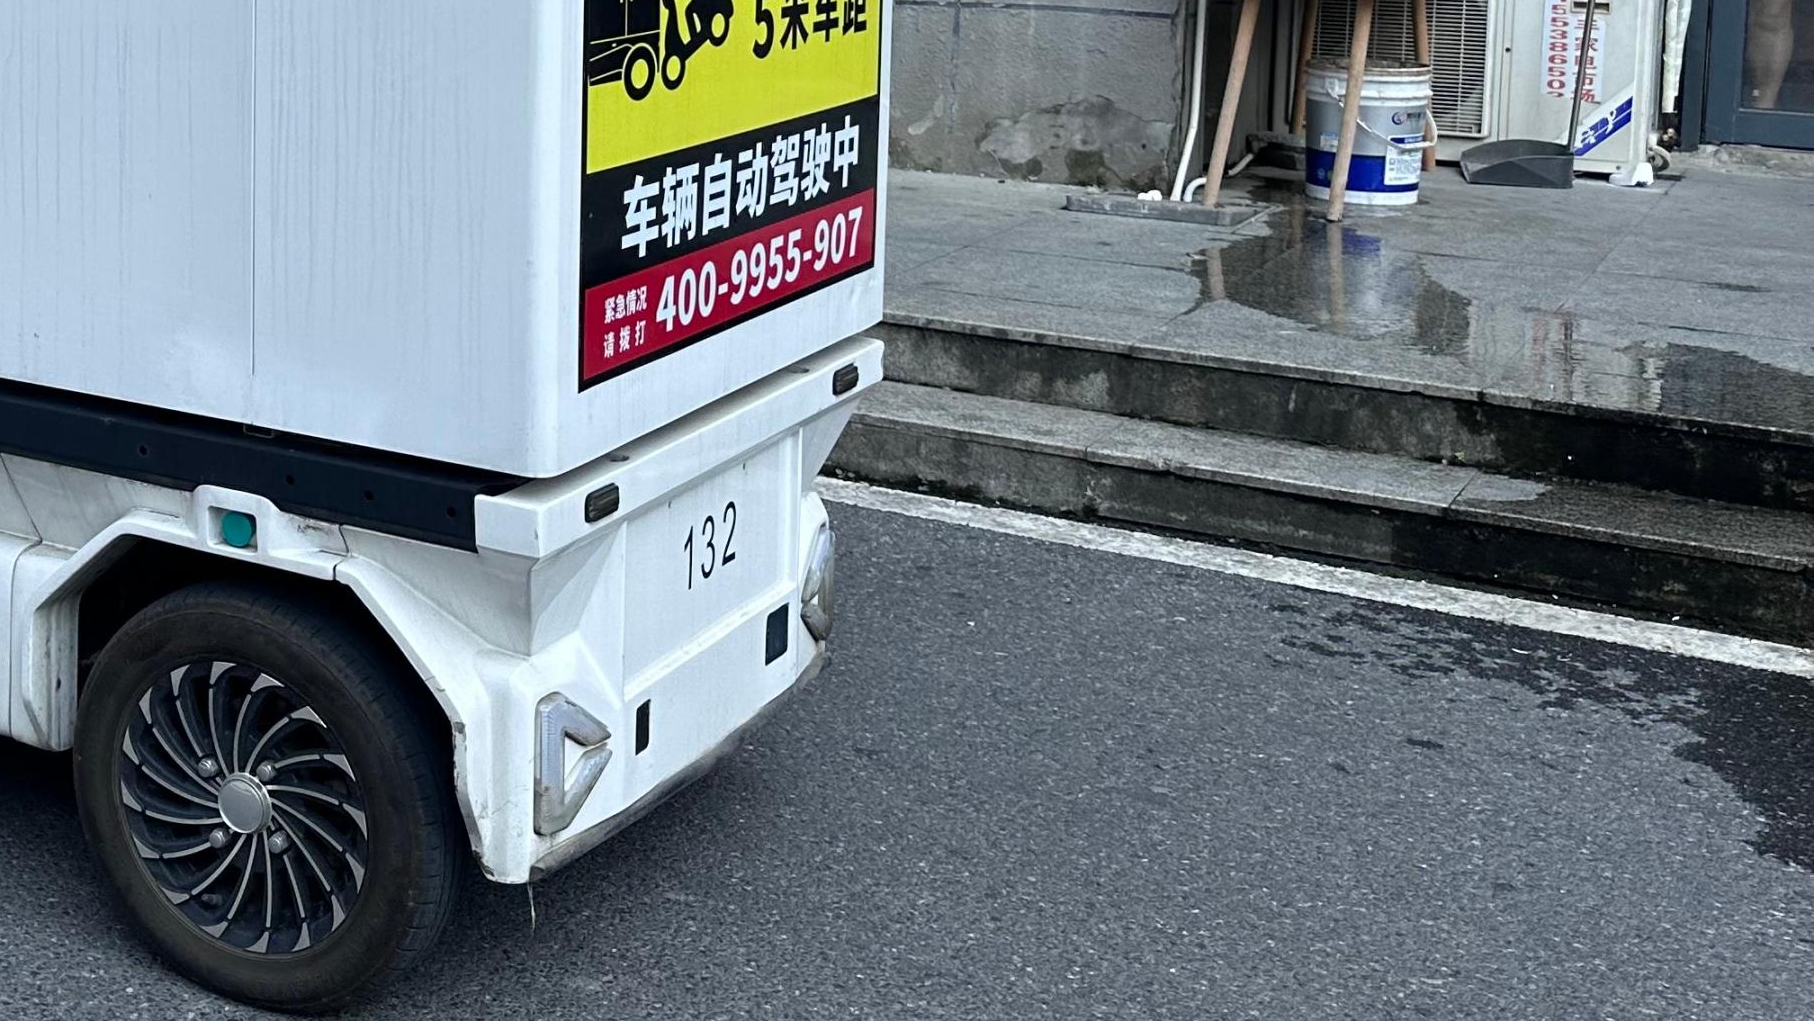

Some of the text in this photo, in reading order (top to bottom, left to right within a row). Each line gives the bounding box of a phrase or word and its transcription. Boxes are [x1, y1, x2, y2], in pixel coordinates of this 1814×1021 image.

[621, 115, 860, 258] 车辆自动驾驶中
[604, 285, 648, 325] 紧急情况
[656, 207, 863, 332] 400-9955-907
[603, 320, 646, 359] 请拨打
[683, 501, 738, 590] 132
